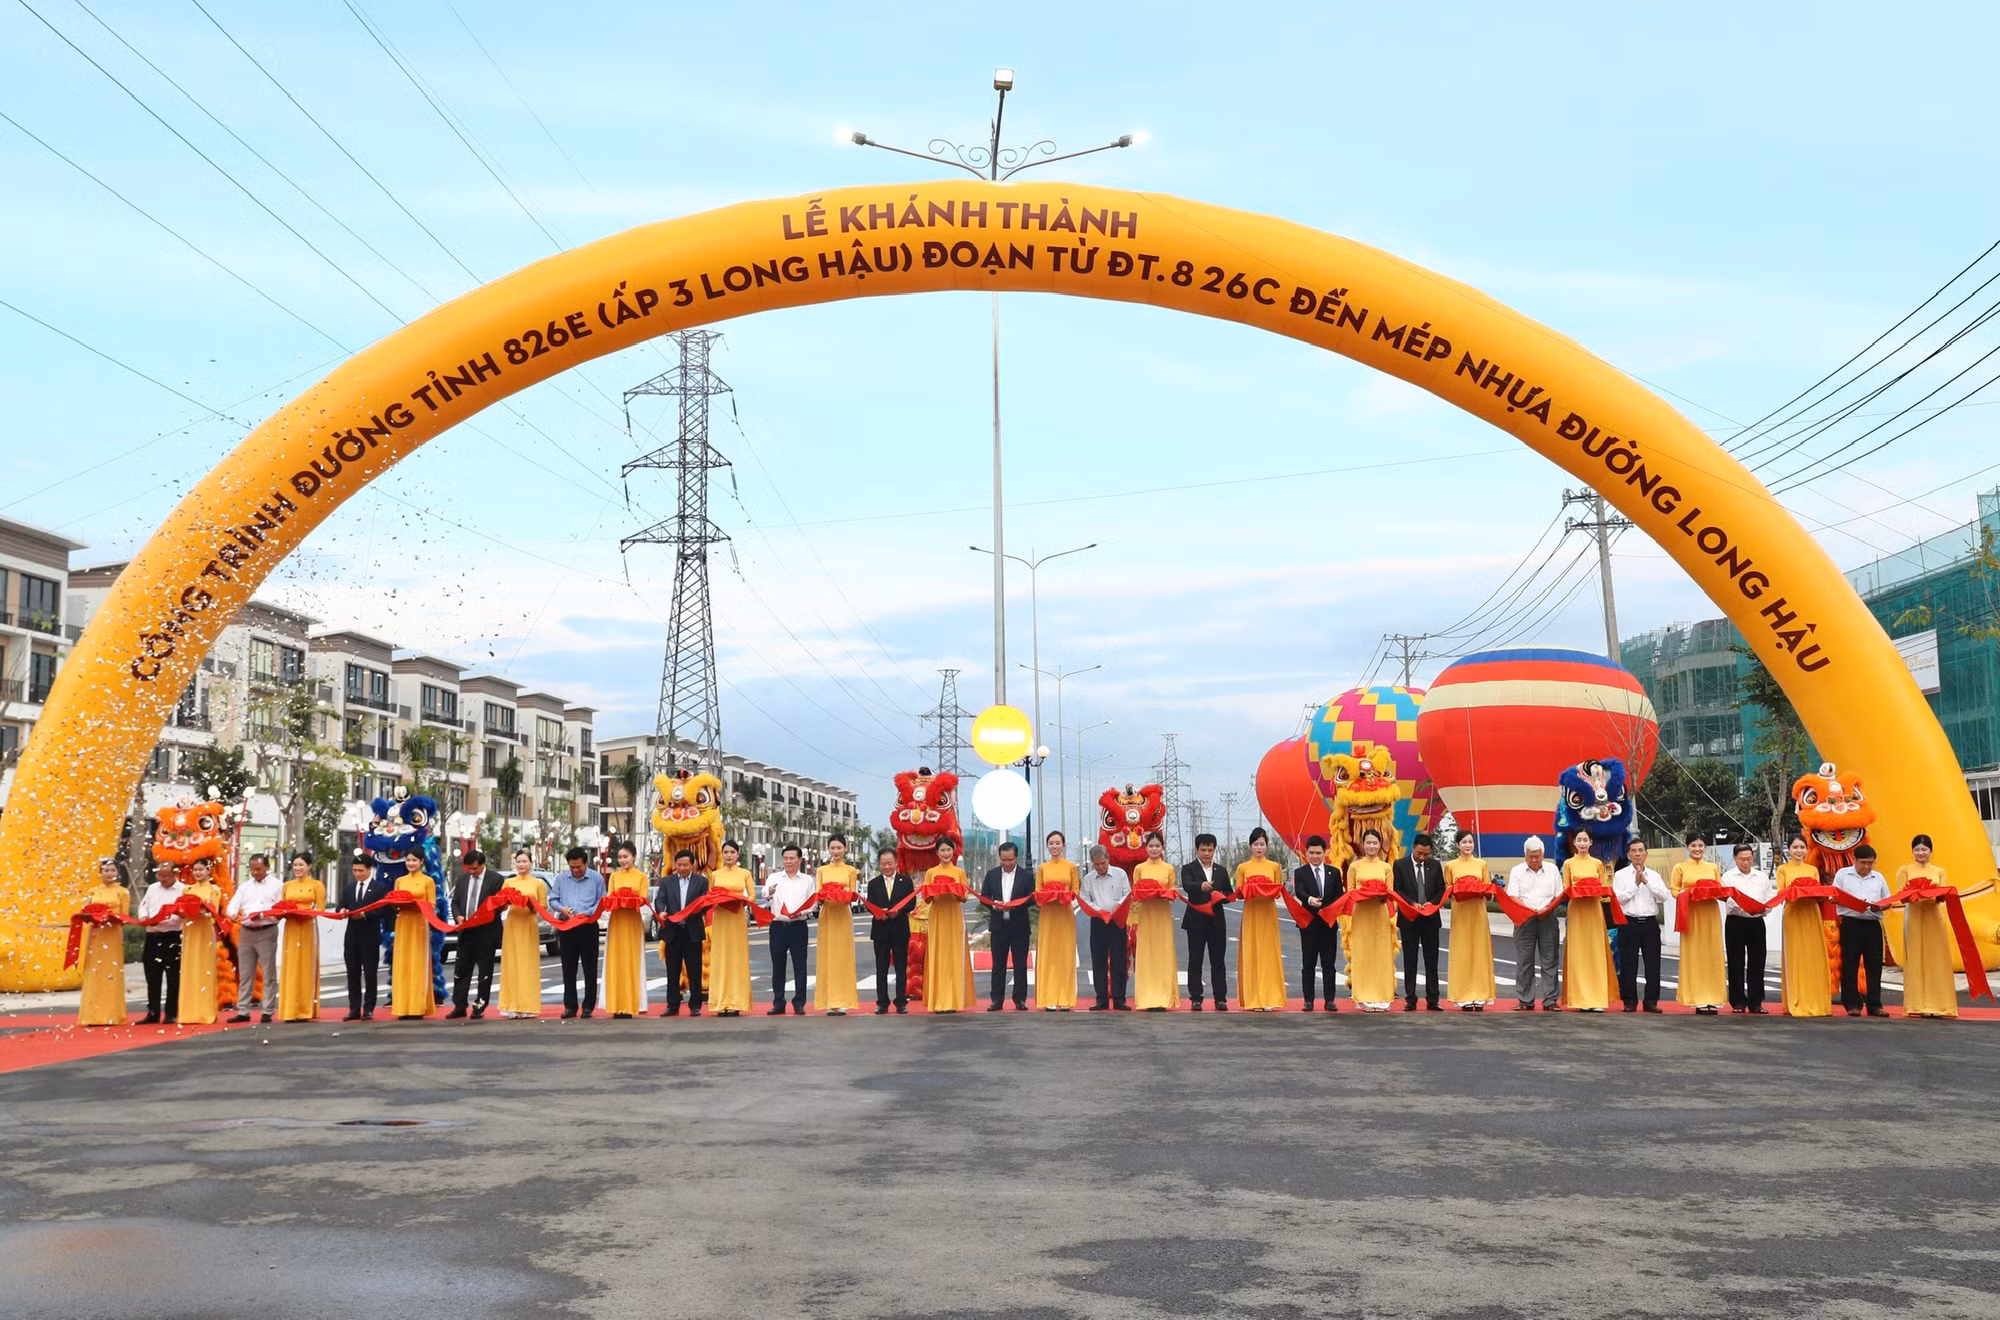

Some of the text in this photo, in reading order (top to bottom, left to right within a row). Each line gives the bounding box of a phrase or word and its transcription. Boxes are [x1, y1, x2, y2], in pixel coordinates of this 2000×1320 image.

[782, 193, 1138, 240] LỄ KHÁNH THÀNH
[289, 402, 416, 498] ĐƯỜNG
[410, 351, 503, 412] TỈNH
[503, 310, 593, 366] 826E
[597, 280, 660, 329] (ẤP
[673, 278, 695, 307] 3
[700, 256, 811, 300] LONG
[818, 237, 913, 280] HẬU)
[921, 240, 1035, 276] ĐOẠN
[1046, 236, 1100, 273] TỪ
[1288, 288, 1369, 334] ĐẾN
[1371, 321, 1453, 363] MÉP
[1454, 350, 1554, 426] NHỰA
[1555, 411, 1682, 515] ĐƯỜNG
[1676, 507, 1770, 600] LONG
[1760, 597, 1832, 673] HẬU
